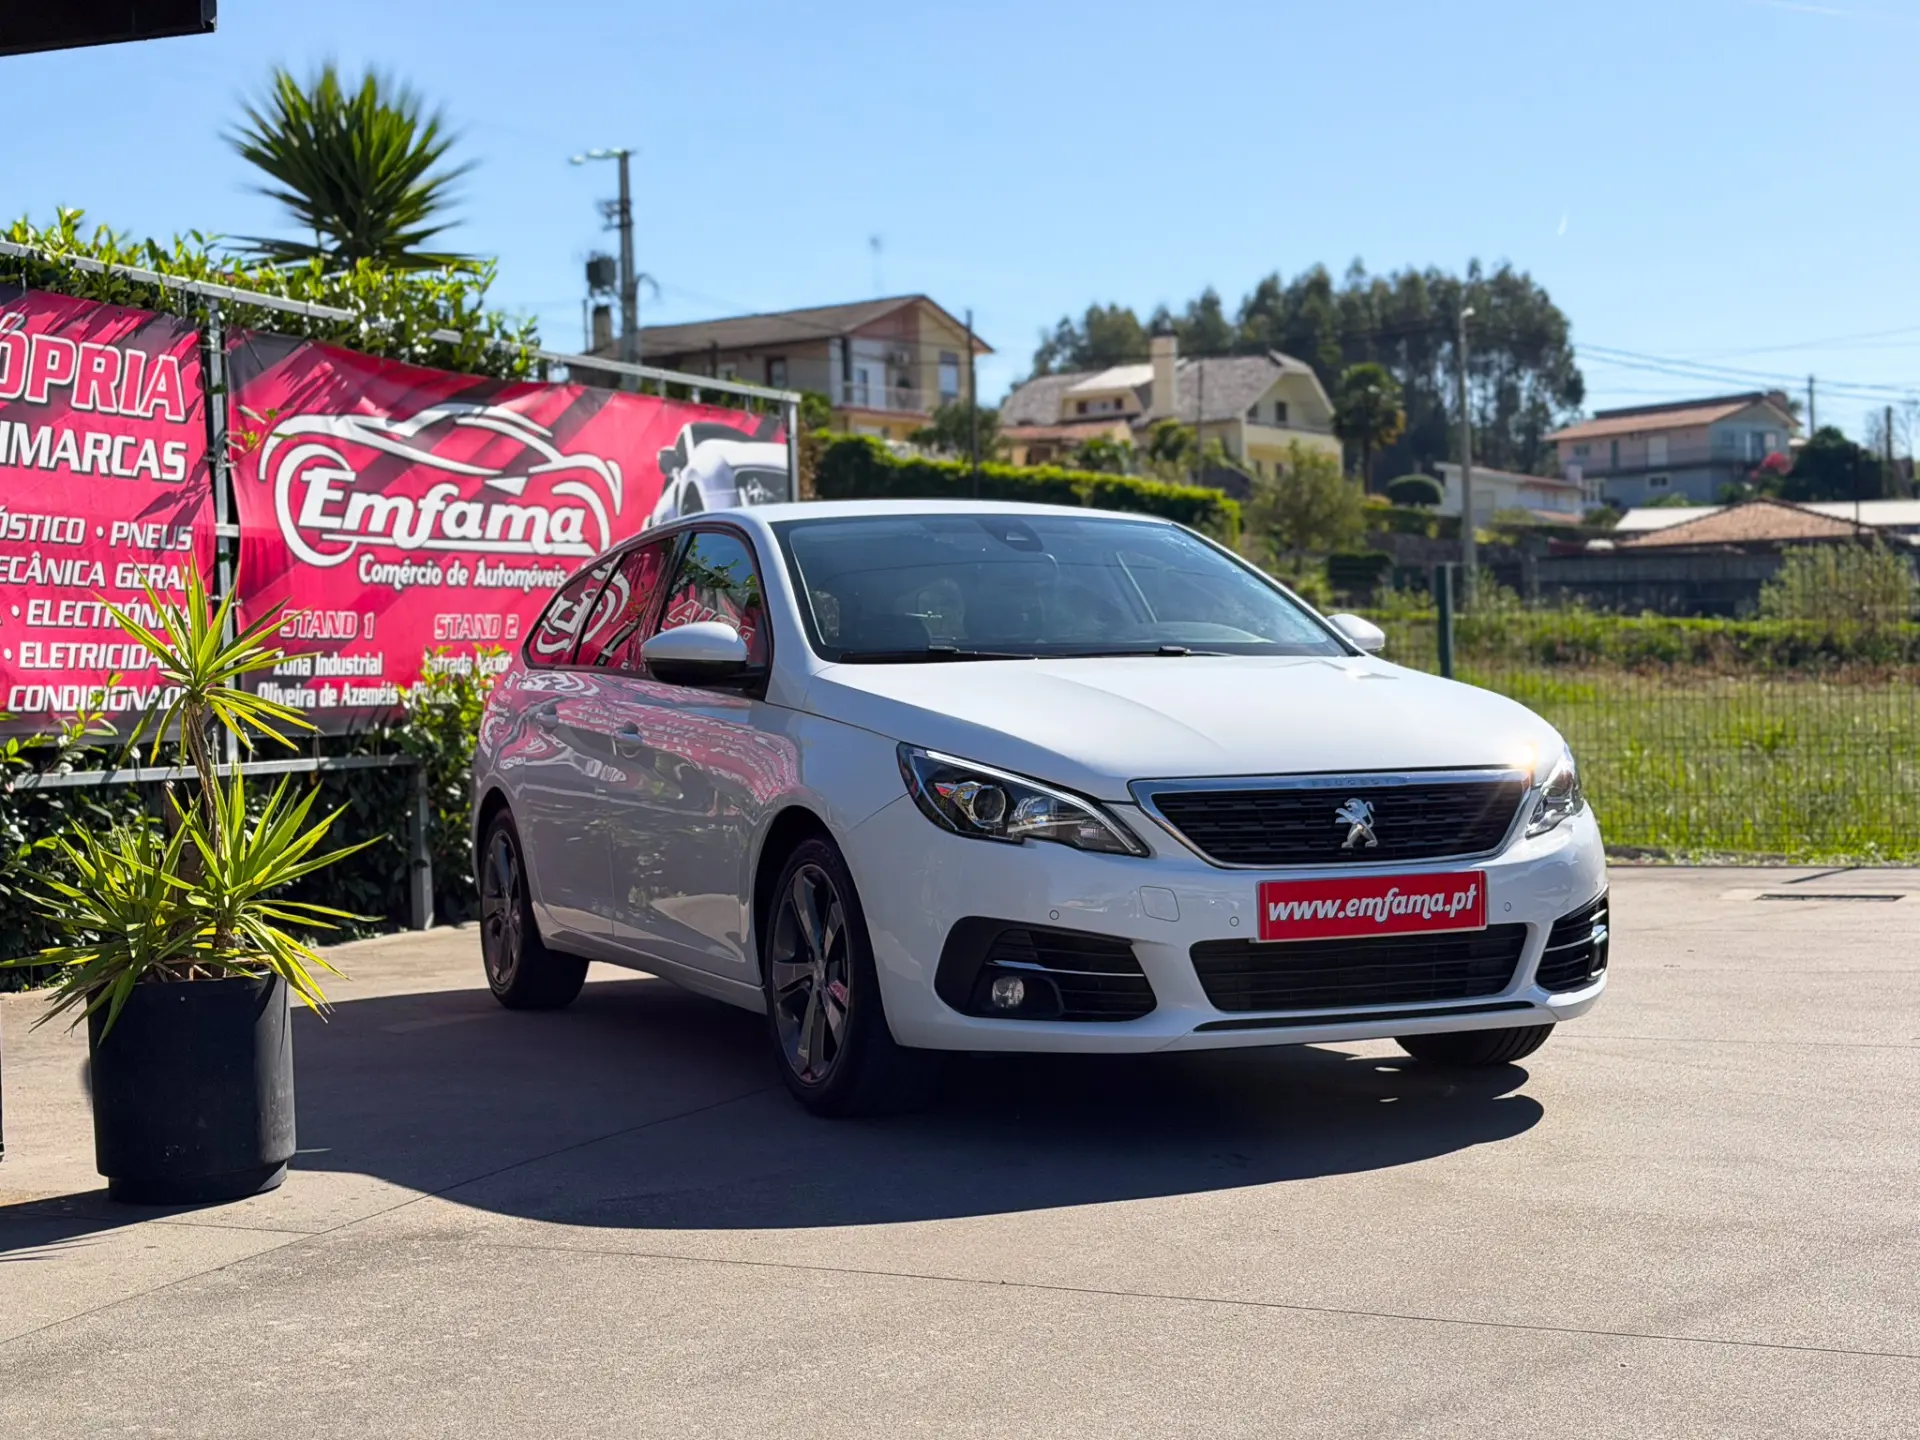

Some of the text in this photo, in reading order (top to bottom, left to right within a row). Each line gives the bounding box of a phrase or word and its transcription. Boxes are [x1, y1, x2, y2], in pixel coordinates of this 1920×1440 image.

[298, 467, 586, 554] Emfama
[109, 521, 193, 550] PNEUS
[359, 553, 567, 592] Comércio de Automóveis
[280, 609, 375, 638] STAND 1
[434, 613, 519, 639] STAND 2
[315, 651, 383, 676] Industrial
[320, 682, 338, 707] de
[340, 680, 399, 706] Azeméis
[1268, 884, 1476, 922] www.emfama.pt
